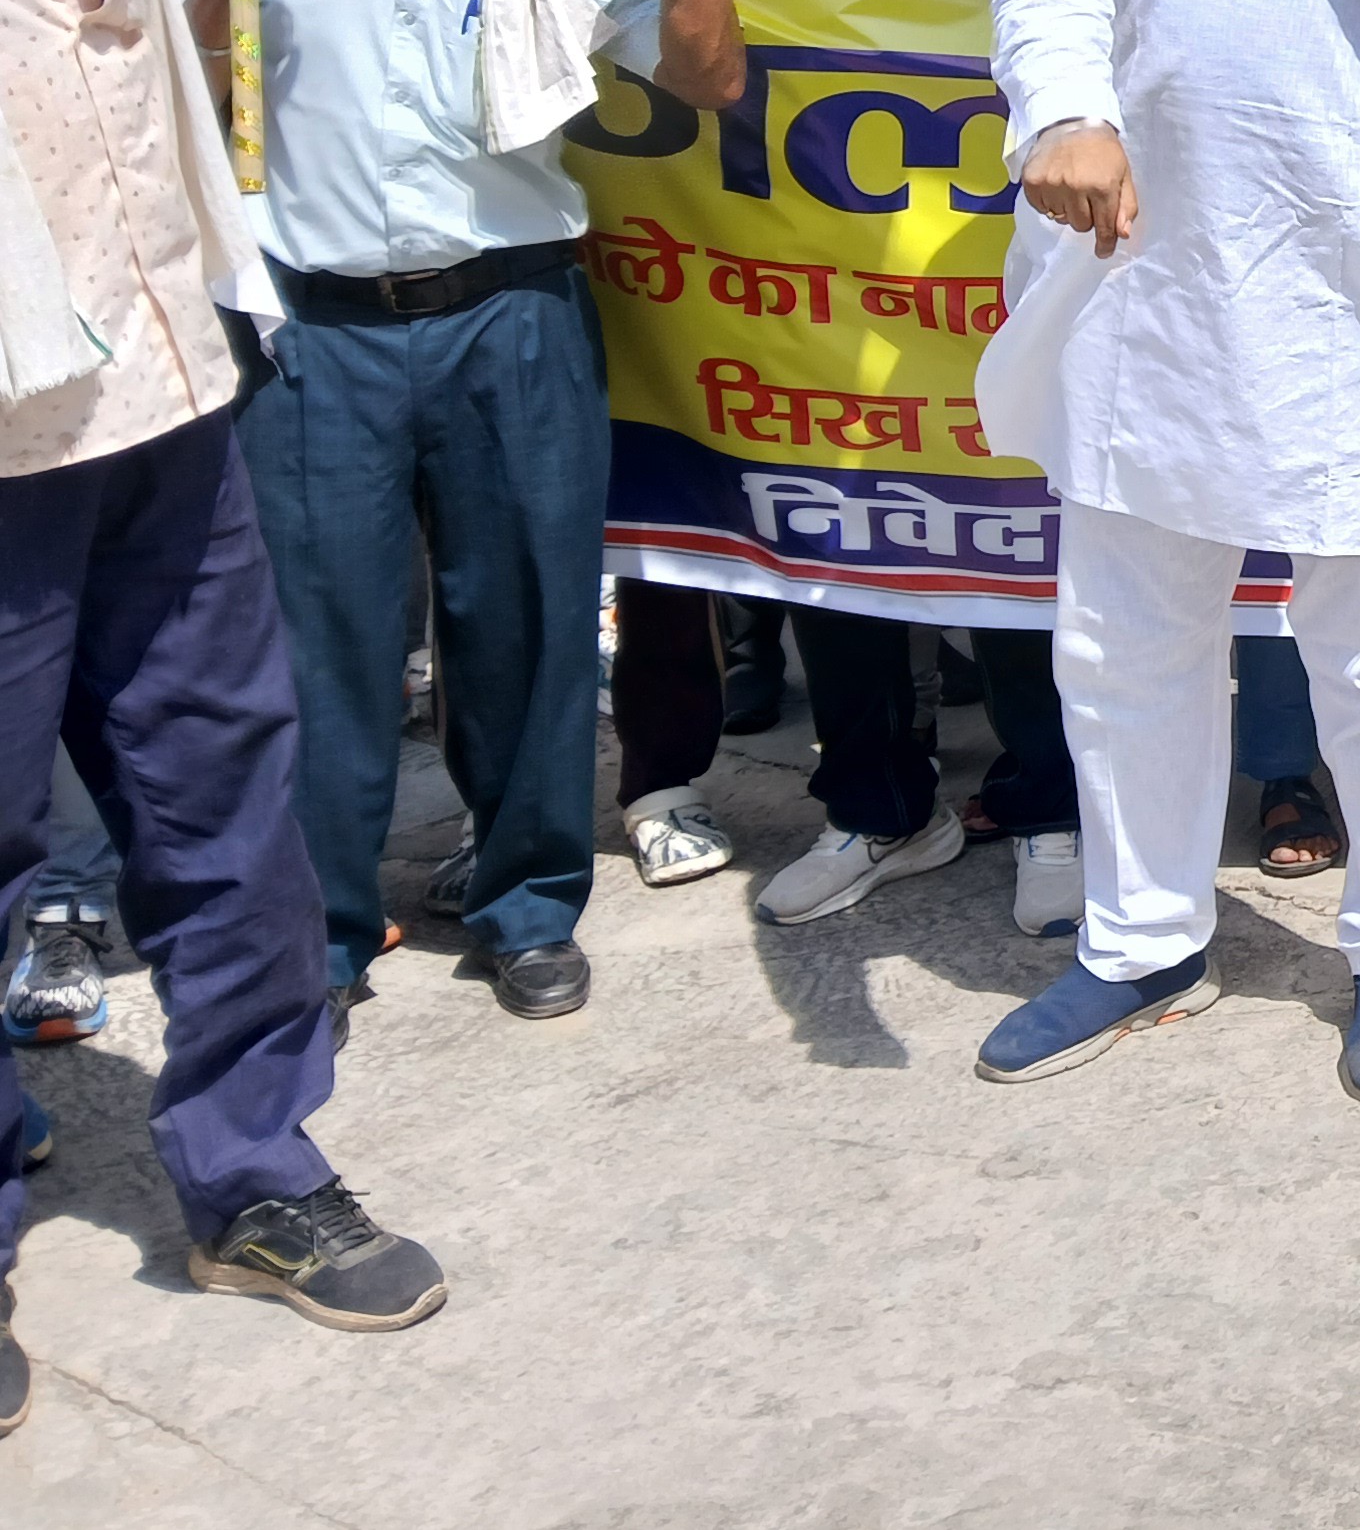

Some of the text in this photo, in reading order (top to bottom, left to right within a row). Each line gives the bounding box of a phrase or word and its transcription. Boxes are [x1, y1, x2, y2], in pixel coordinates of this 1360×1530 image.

[706, 246, 837, 324] का
[695, 357, 929, 454] सिख
[741, 471, 1062, 563] निवेद
